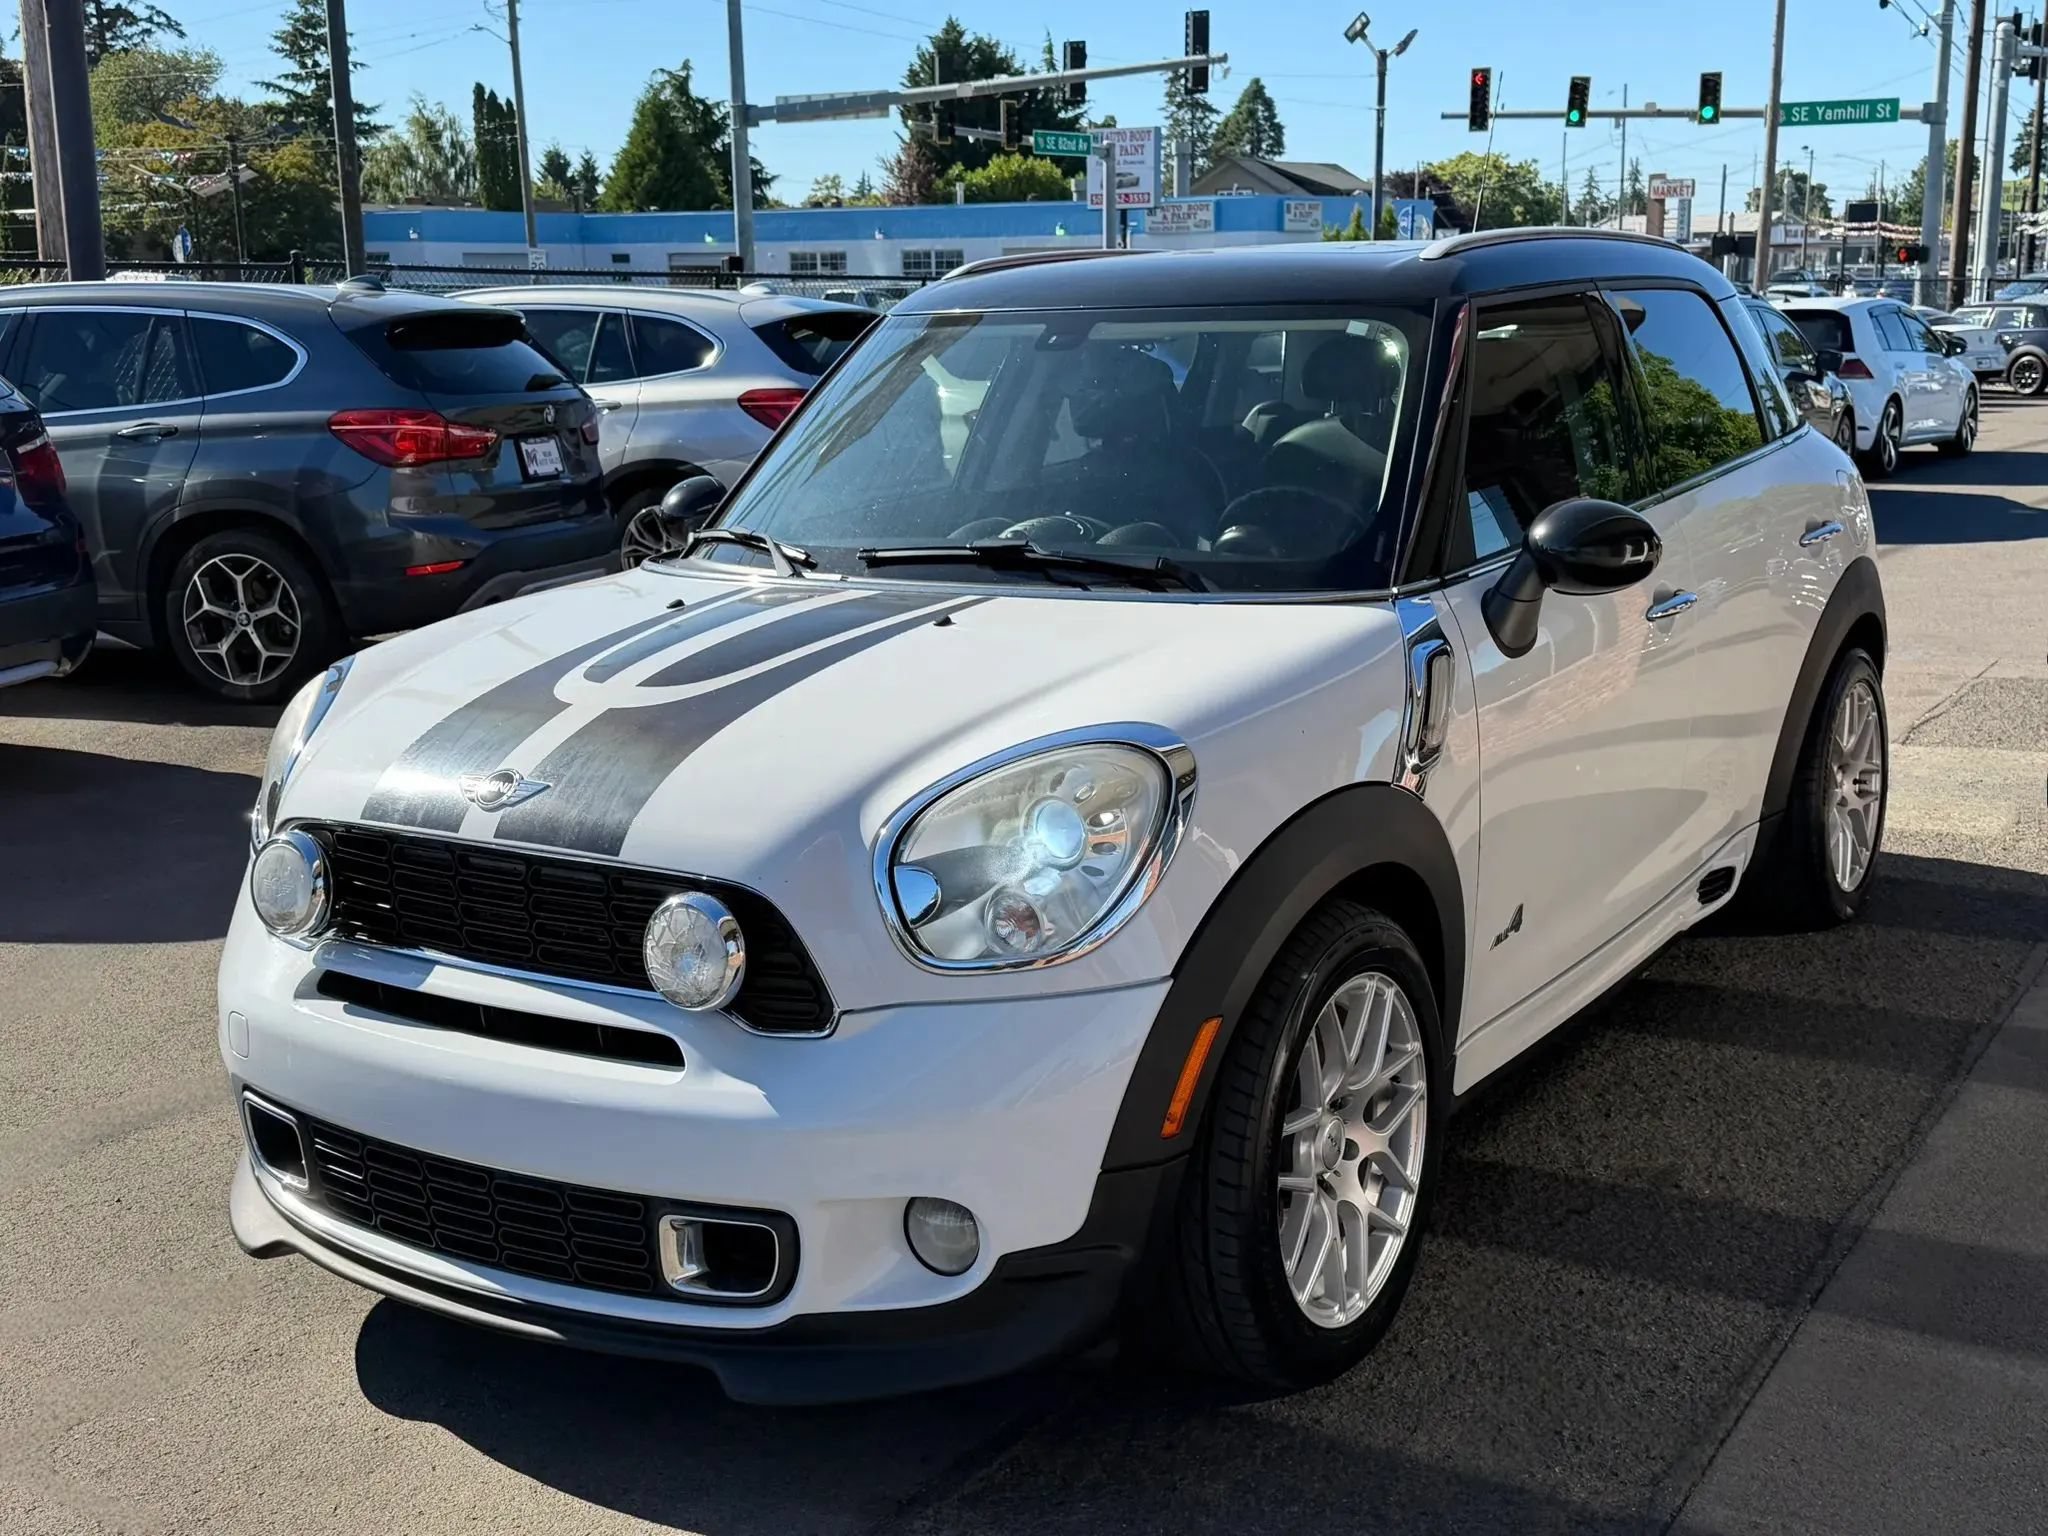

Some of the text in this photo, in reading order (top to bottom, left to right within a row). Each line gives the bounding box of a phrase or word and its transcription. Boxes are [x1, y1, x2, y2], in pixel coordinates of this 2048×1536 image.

[1792, 103, 1891, 121] SE Yamhill St
[1130, 130, 1152, 141] BODY
[1046, 136, 1057, 150] SE
[1078, 137, 1088, 152] Av
[1120, 144, 1145, 156] PAINT
[1652, 184, 1691, 197] MARKET
